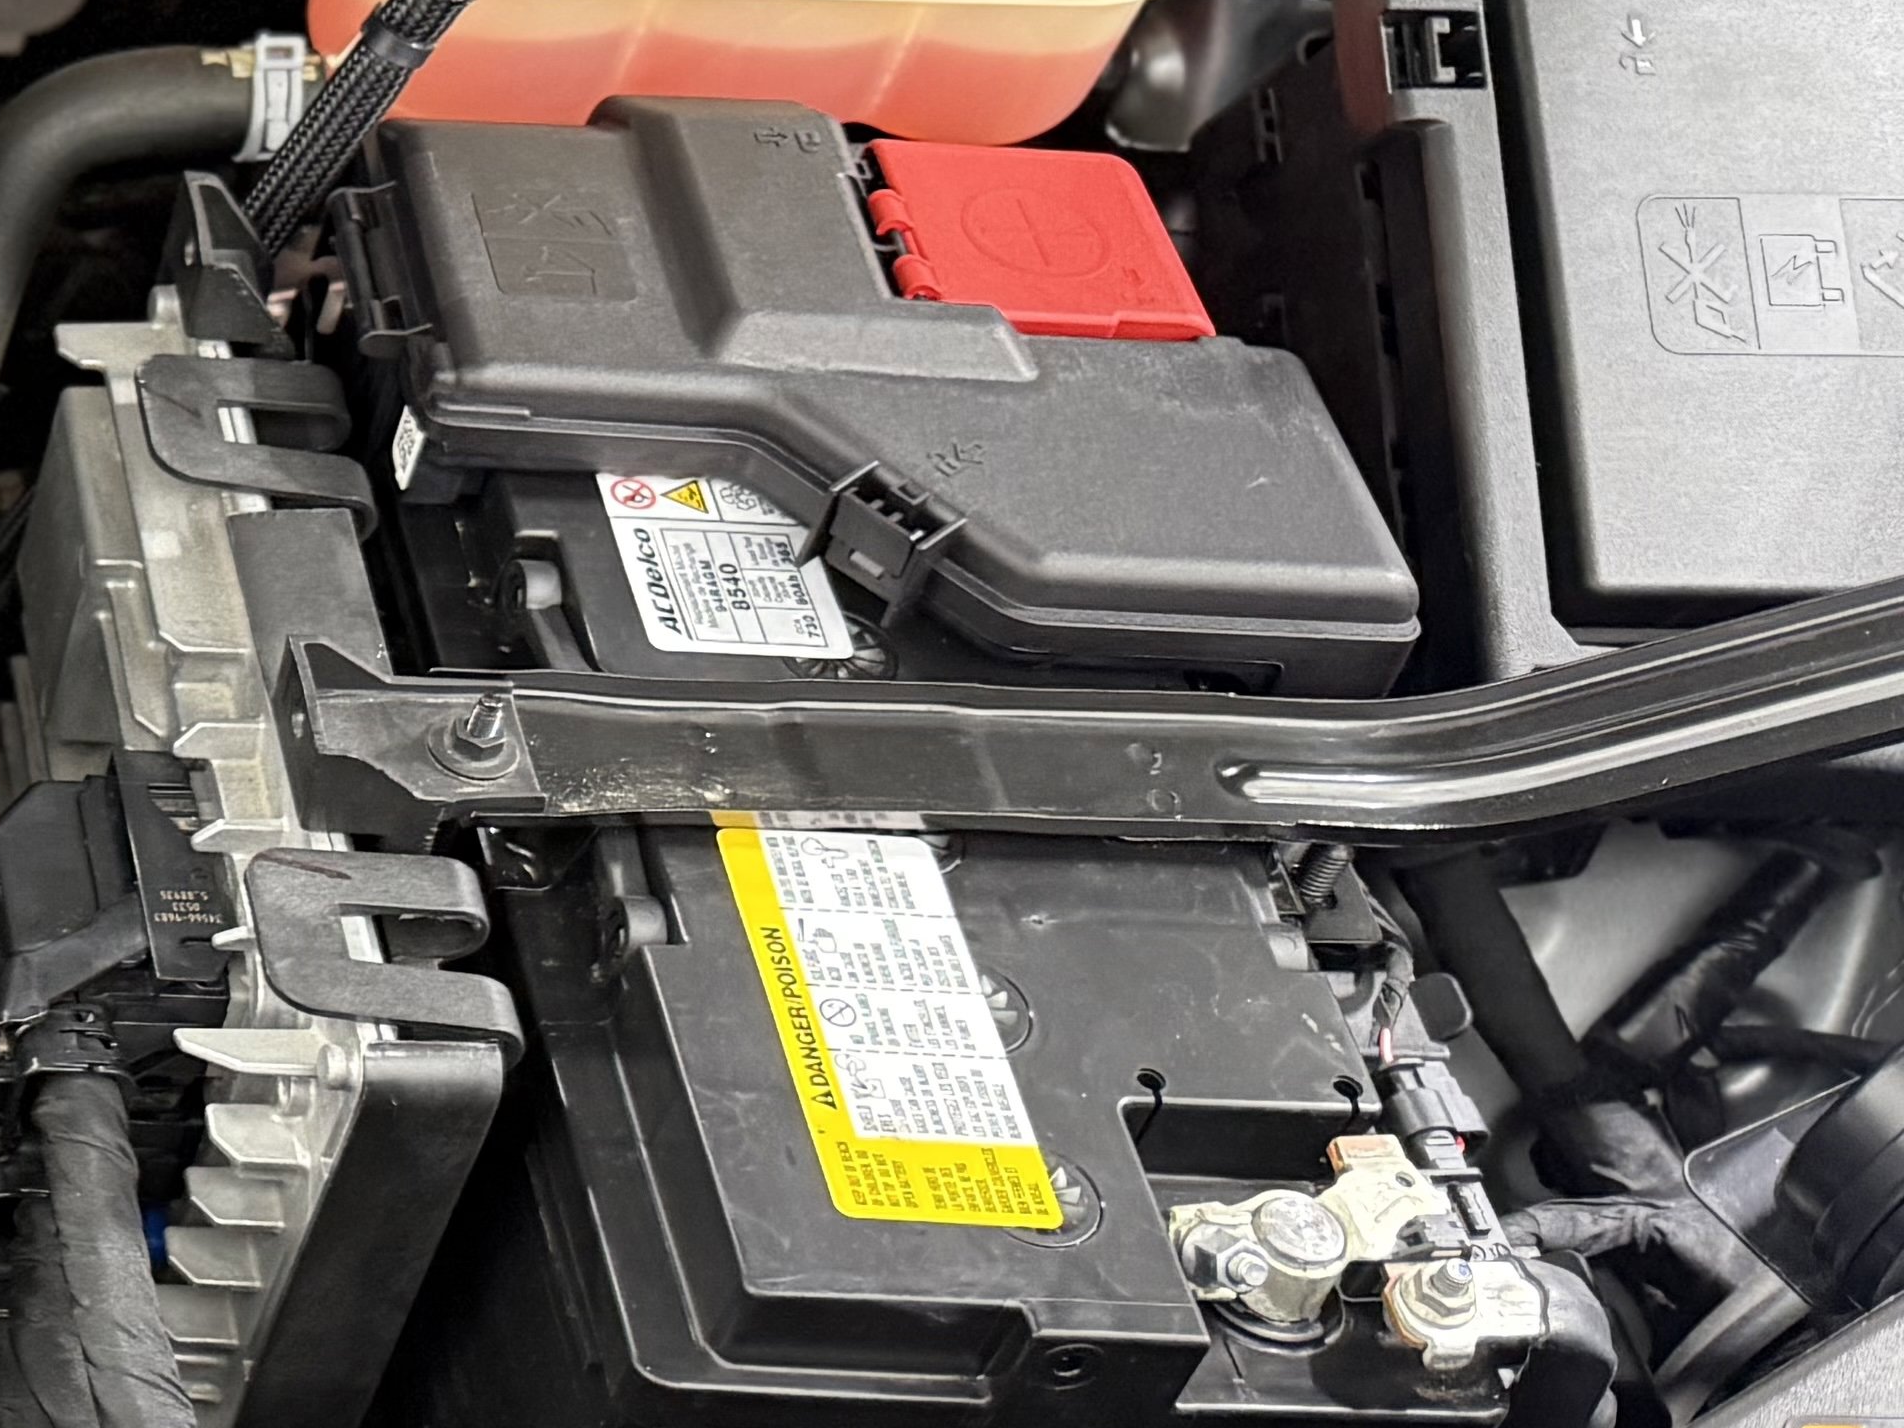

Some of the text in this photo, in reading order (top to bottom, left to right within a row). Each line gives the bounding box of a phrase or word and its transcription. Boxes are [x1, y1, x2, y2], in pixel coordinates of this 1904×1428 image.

[632, 528, 681, 634] ACDelco
[717, 563, 751, 609] 8540
[759, 927, 829, 1085] DANGER/POISON
